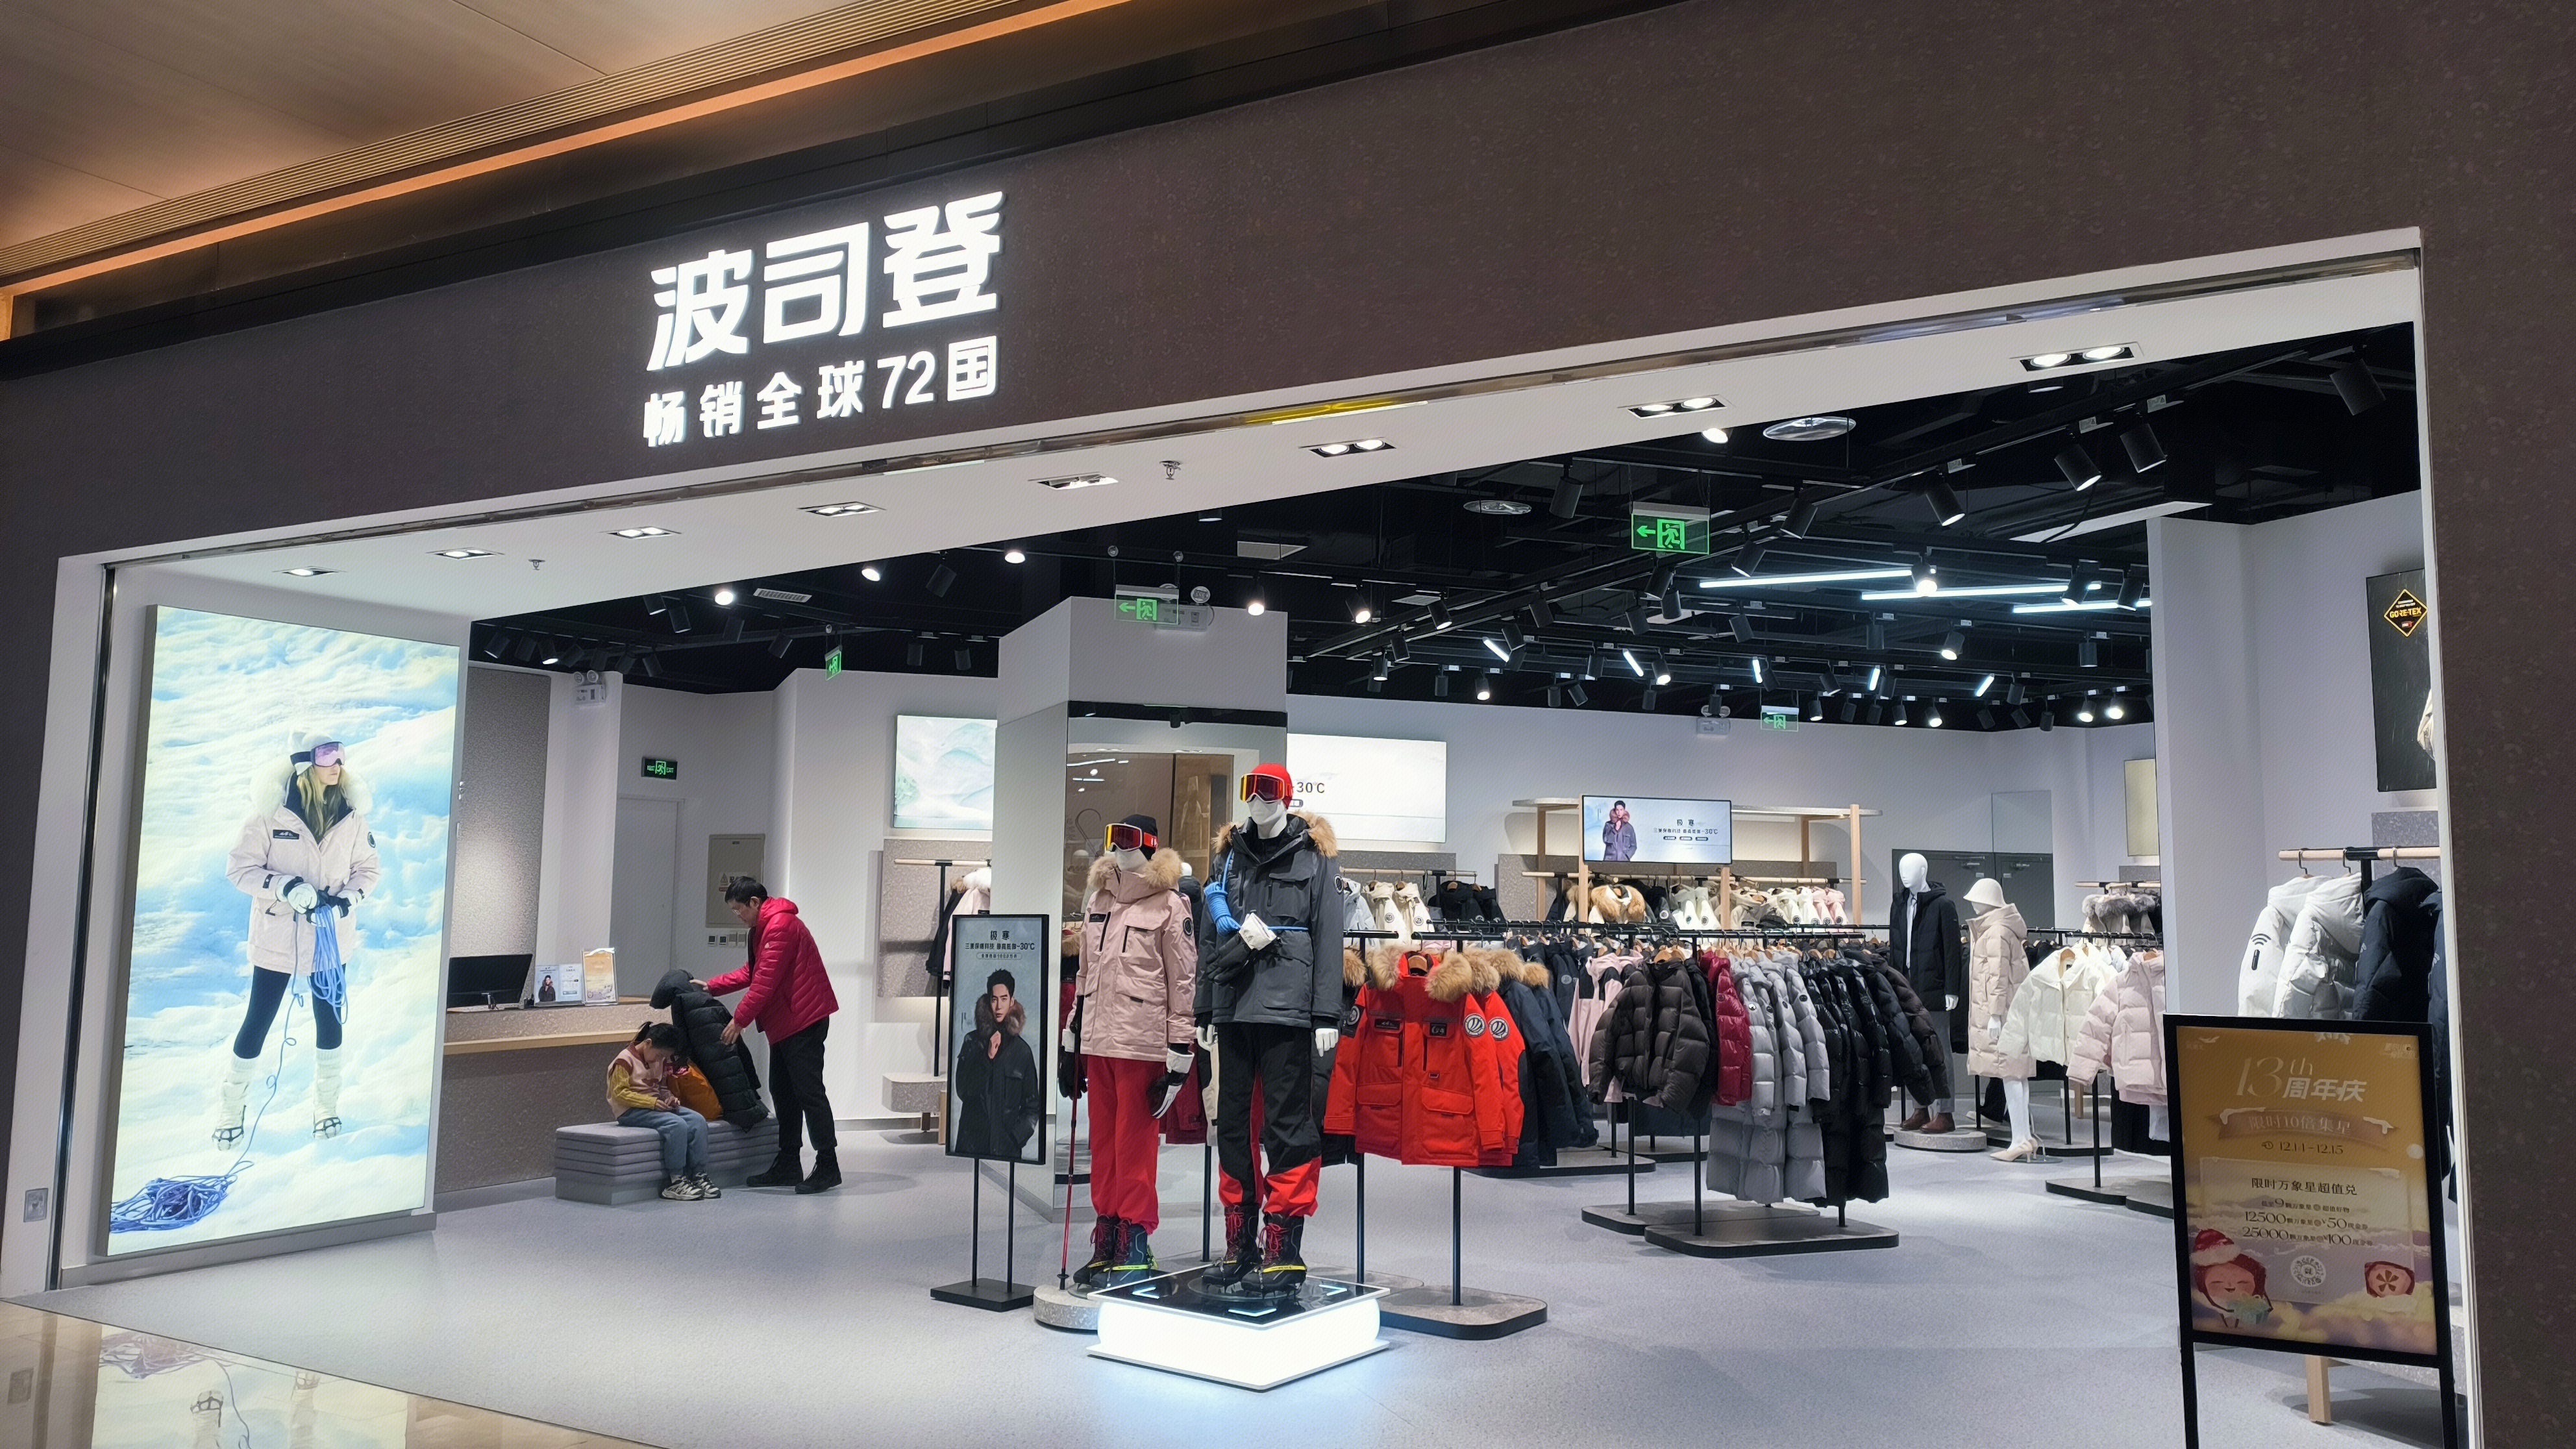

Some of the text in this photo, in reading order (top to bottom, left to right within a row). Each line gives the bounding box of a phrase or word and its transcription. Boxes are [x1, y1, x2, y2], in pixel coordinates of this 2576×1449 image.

[647, 191, 1003, 371] 波司登
[643, 335, 997, 447] 畅销全球72国
[2282, 1077, 2368, 1102] 周年庆
[2251, 1178, 2357, 1195] 限时万象星超值兑
